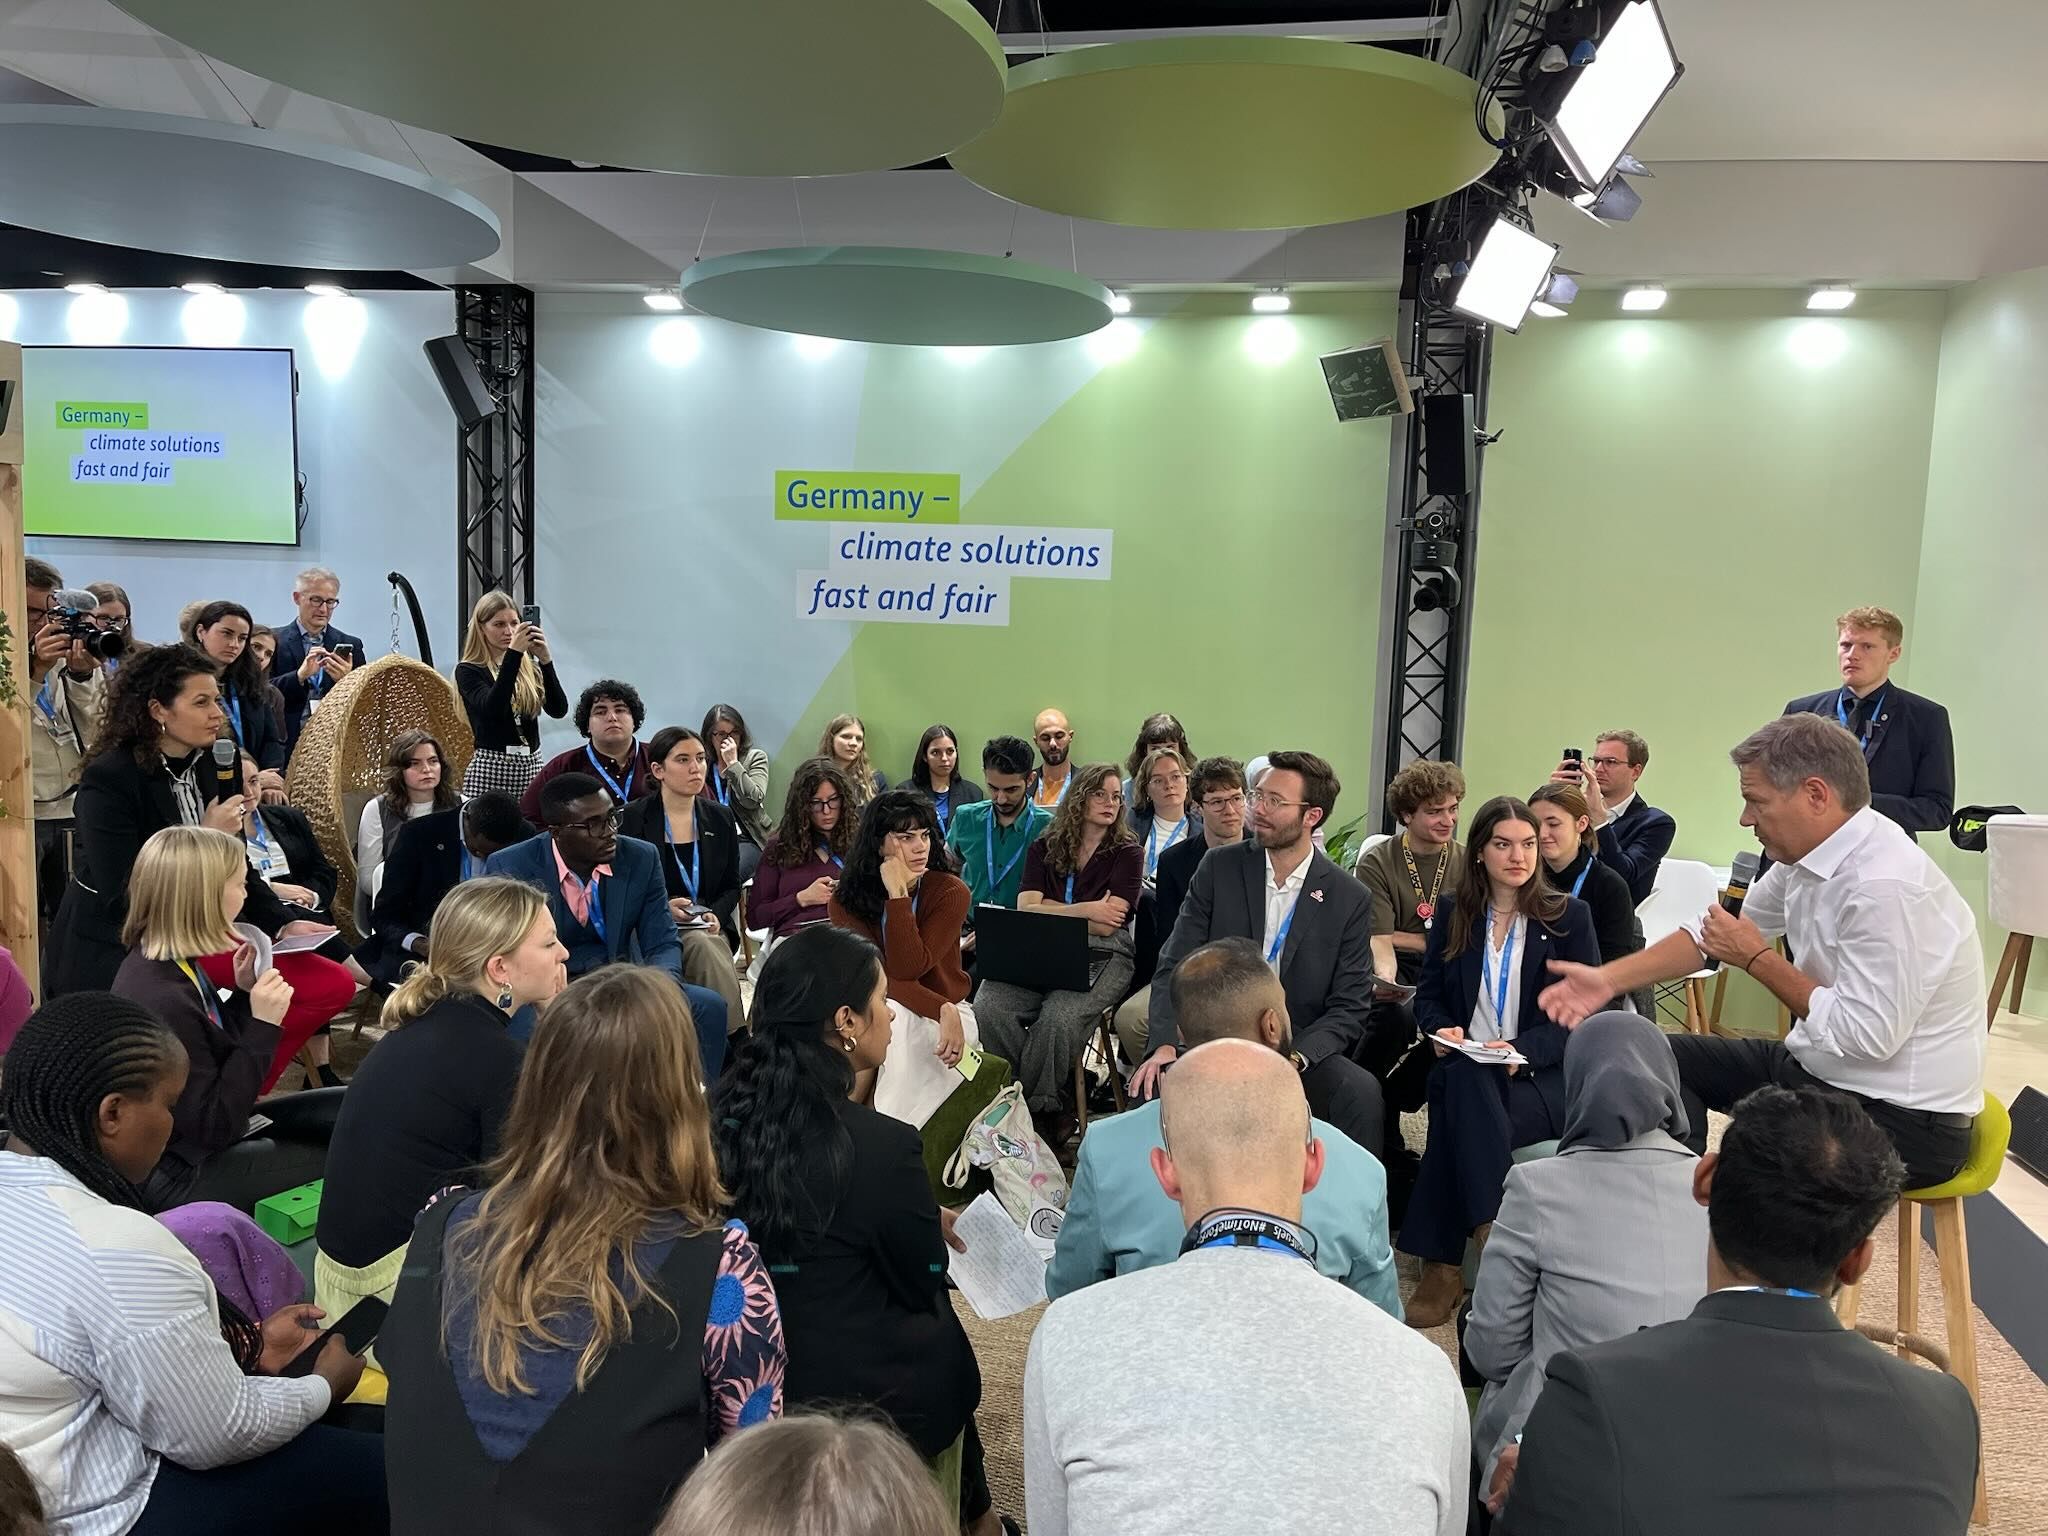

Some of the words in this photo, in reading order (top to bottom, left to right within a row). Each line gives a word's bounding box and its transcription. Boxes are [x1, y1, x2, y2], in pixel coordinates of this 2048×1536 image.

[62, 406, 130, 427] Germany
[89, 434, 146, 451] climate
[150, 435, 220, 453] solutions
[75, 460, 105, 480] fast
[110, 461, 139, 477] and
[141, 461, 171, 481] fair
[787, 479, 924, 518] Germany
[840, 531, 952, 562] climate
[960, 535, 1100, 567] solutions
[808, 579, 869, 615] fast
[878, 583, 935, 612] and
[939, 583, 998, 619] fair
